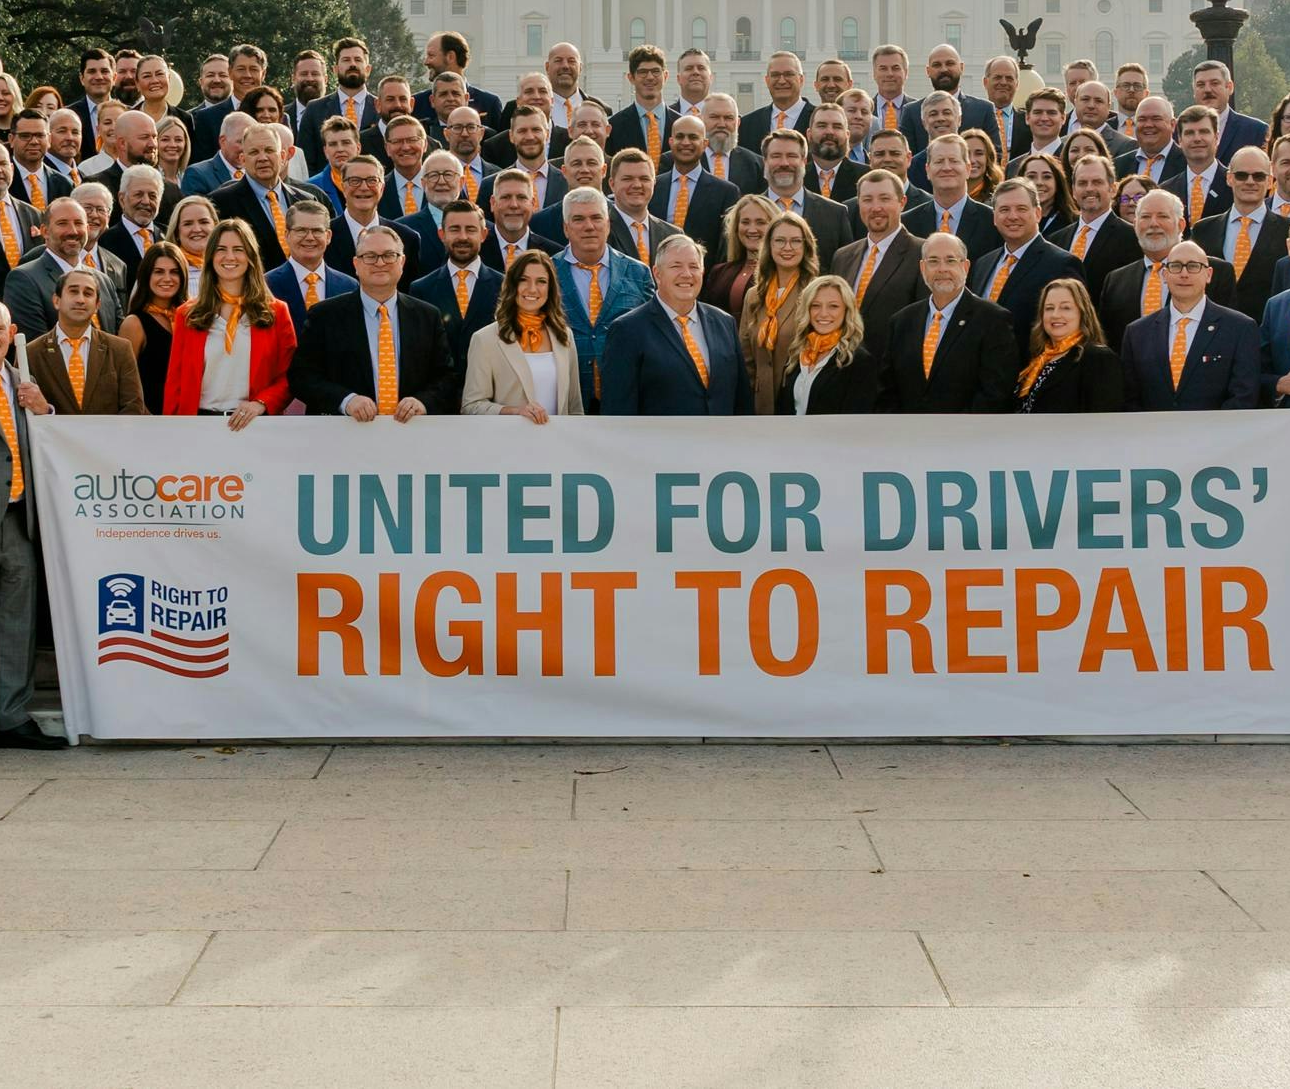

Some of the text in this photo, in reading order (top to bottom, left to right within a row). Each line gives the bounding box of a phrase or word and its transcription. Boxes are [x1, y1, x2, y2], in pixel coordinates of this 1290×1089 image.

[75, 503, 244, 520] ASSOCIATION
[297, 466, 1269, 556] UNITED FOR DRIVERS’
[95, 527, 222, 541] Independence drives us.
[151, 579, 229, 606] RIGHT TO
[151, 601, 228, 632] REPAIR
[296, 565, 1275, 678] RIGHT TO REPAIR
